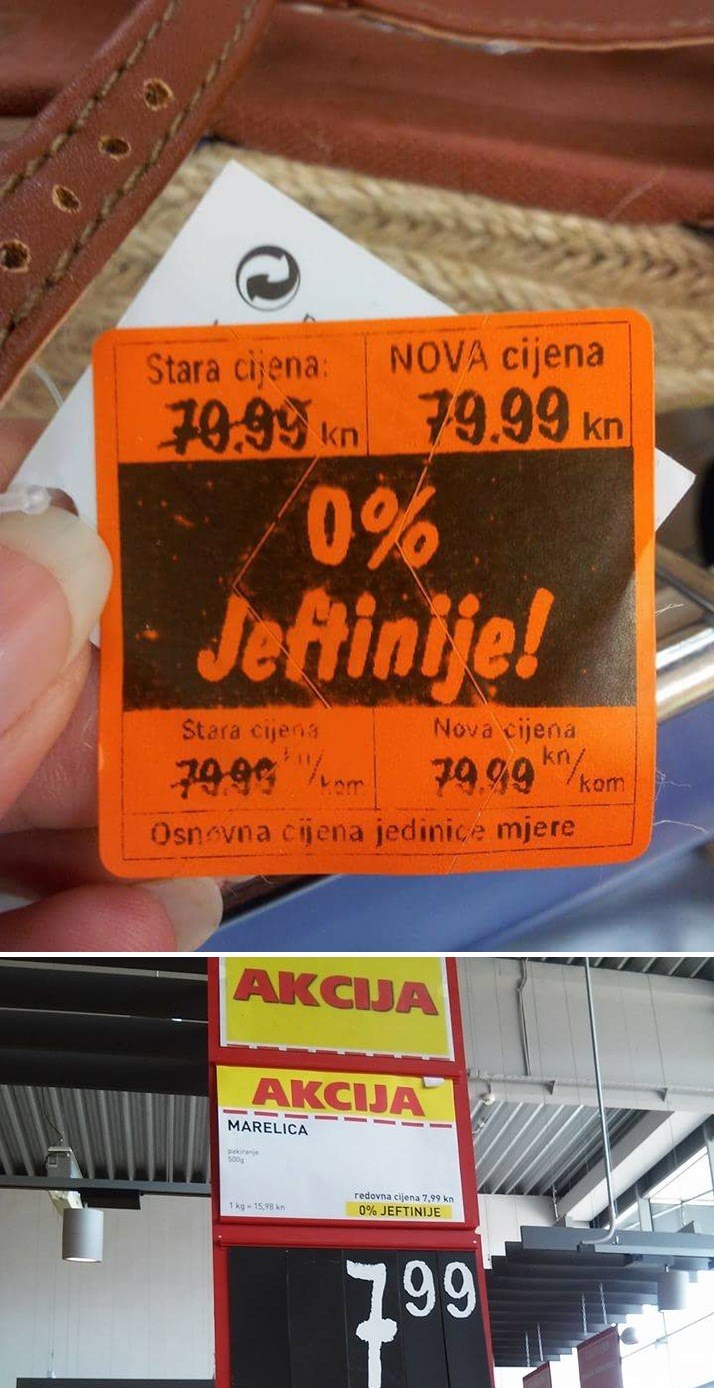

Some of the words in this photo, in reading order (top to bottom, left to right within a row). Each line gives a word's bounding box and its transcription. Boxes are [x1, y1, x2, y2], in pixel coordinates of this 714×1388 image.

[146, 352, 221, 386] Stara
[234, 350, 328, 390] cijena:
[390, 340, 489, 374] NOVA
[502, 336, 605, 379] cijena
[320, 421, 359, 448] kn
[418, 386, 569, 446] 79.99
[582, 412, 624, 441] kn
[307, 484, 440, 570] 0%
[197, 587, 555, 704] Jeftinije!
[181, 717, 241, 742] Stara
[250, 718, 319, 744] cijena
[433, 717, 494, 740] Nova
[503, 717, 576, 745] cijena
[431, 756, 535, 798] 79.99
[151, 820, 271, 846] Osnovna
[281, 817, 364, 848] cijena
[375, 817, 486, 847] jedinice
[496, 814, 577, 844] mjere
[233, 967, 439, 1016] AKCIJA
[252, 1077, 425, 1117] AKCIJA
[227, 1119, 309, 1137] MARELICA
[235, 1202, 246, 1212] kg
[354, 1192, 392, 1201] redovna
[394, 1193, 420, 1203] cijena
[422, 1194, 441, 1203] 7,99
[443, 1195, 455, 1203] kn
[358, 1204, 378, 1217] 0%
[380, 1205, 441, 1218] JEFTINIJE
